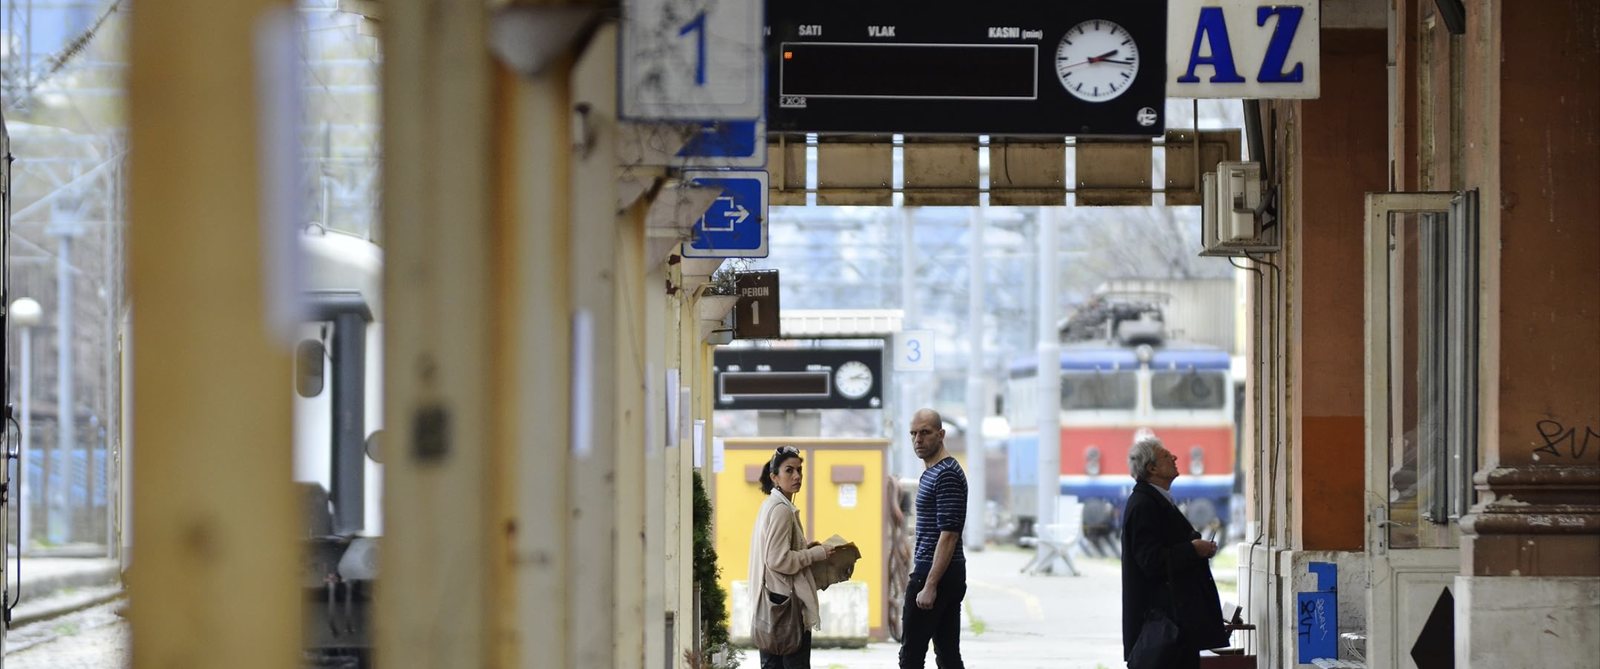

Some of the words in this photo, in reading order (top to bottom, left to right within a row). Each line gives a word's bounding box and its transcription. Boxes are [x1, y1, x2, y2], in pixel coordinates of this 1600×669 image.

[798, 24, 822, 36] SATI
[868, 25, 896, 37] VLAK
[988, 26, 1020, 38] KASNI
[1021, 29, 1044, 40] (min)
[678, 11, 708, 86] 1
[1177, 6, 1304, 84] AZ
[779, 96, 807, 107] EXOR
[742, 286, 769, 297] PERON
[750, 300, 760, 325] 1
[906, 339, 922, 362] 3
